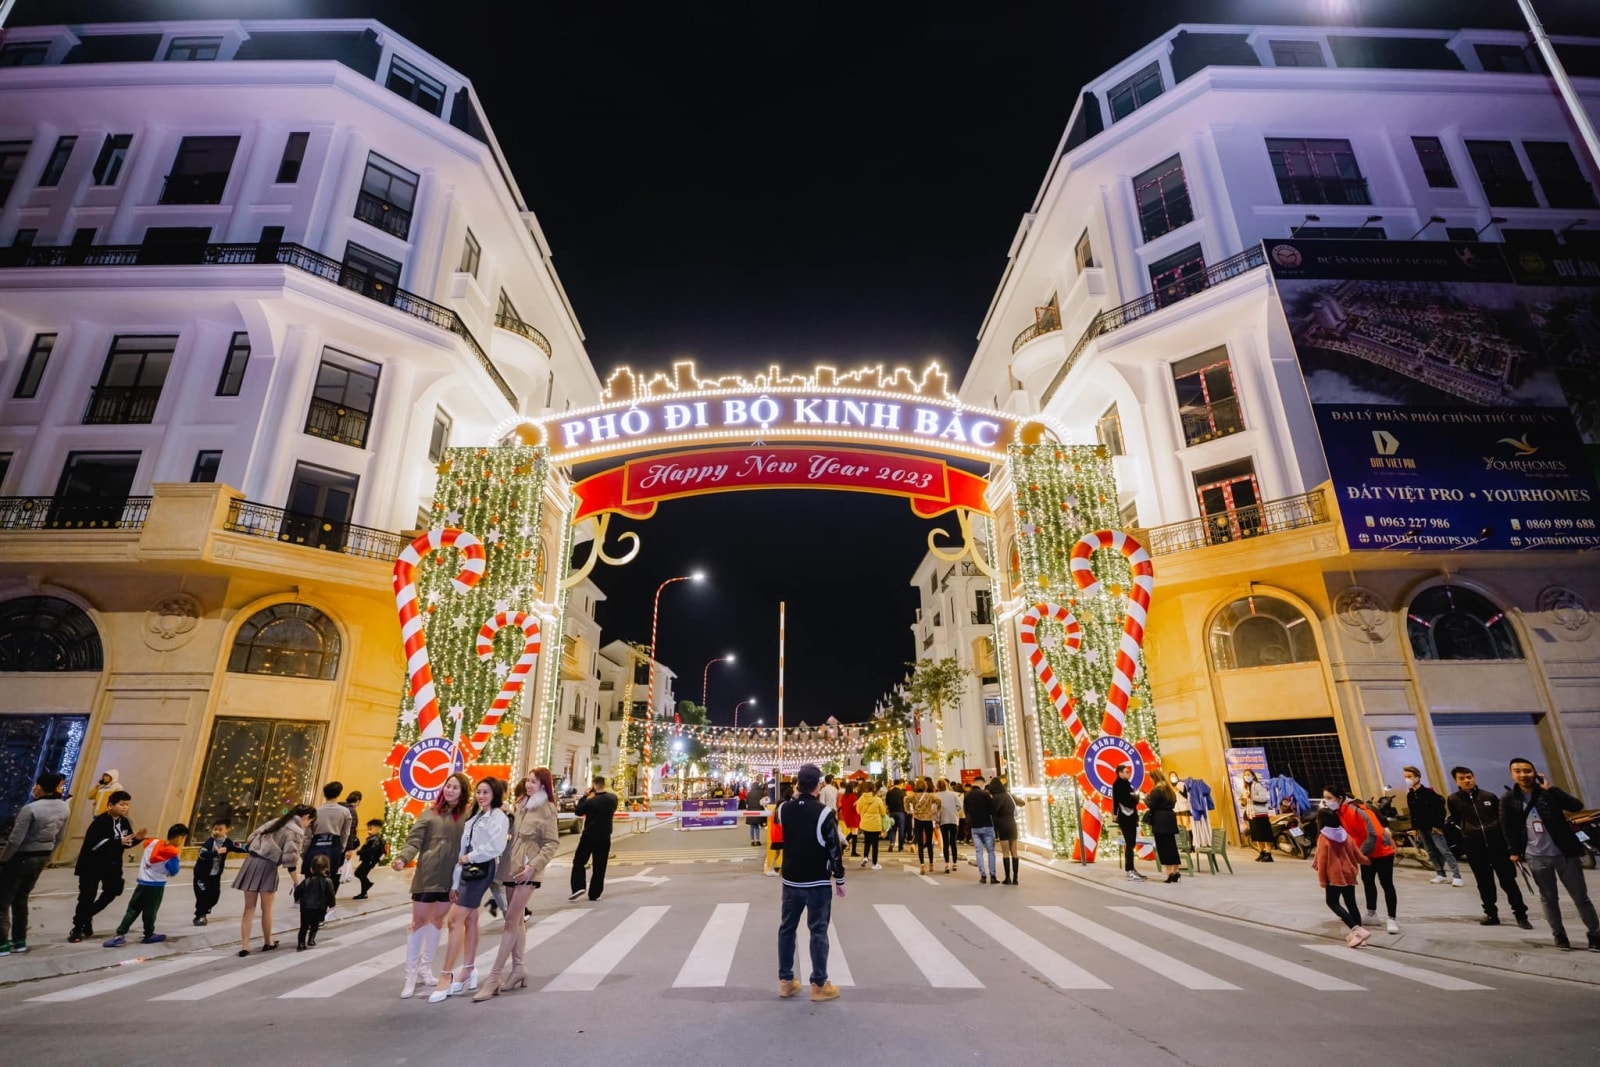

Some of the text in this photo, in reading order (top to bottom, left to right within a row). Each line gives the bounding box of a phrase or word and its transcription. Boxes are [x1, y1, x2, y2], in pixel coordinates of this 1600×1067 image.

[1357, 408, 1373, 421] LÝ
[561, 395, 1000, 449] PHỐ ĐI BỘ KINH BẮC
[640, 454, 933, 489] Happy New Year 2023
[1385, 485, 1426, 503] VIỆT
[1429, 487, 1464, 501] PRO
[1482, 488, 1591, 502] YOURHOMES
[1380, 517, 1450, 529] 0963 227 986
[1526, 518, 1596, 529] 0869 899 688
[1118, 741, 1135, 755] DUC
[410, 788, 440, 800] GROU
